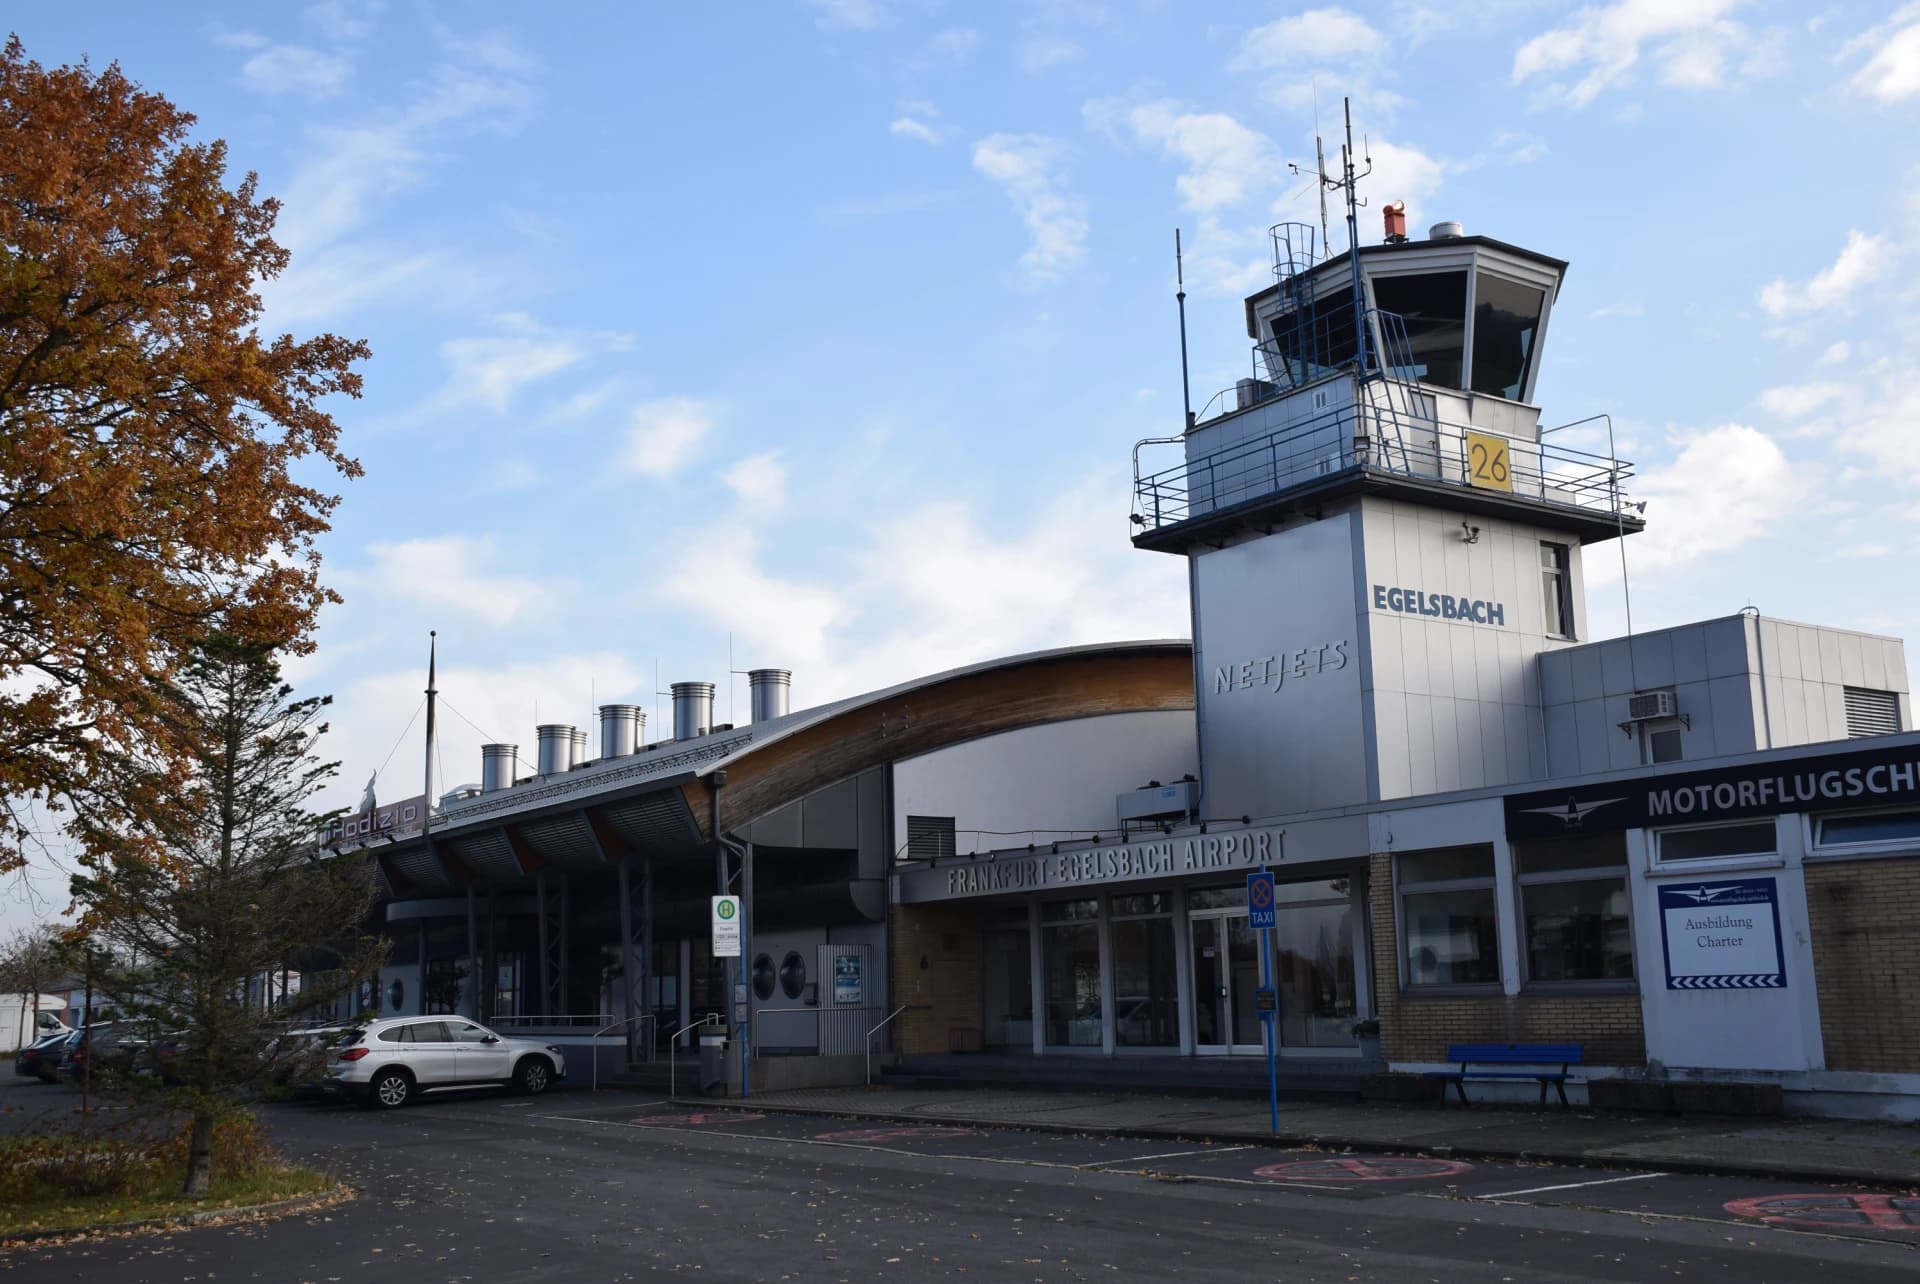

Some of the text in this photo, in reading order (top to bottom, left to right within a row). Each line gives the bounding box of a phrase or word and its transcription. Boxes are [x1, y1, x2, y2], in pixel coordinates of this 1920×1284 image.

[1471, 442, 1507, 483] 26
[1373, 584, 1505, 626] EGELSBACH
[1214, 640, 1349, 695] NETJETS
[1648, 760, 1920, 817] MOTORFLUGSCH
[947, 828, 1288, 896] FRANKFURT-EGELSBACH AIRPORT
[1251, 911, 1274, 925] TAXI
[1685, 914, 1753, 932] Ausbildung
[1697, 933, 1744, 949] Charter
